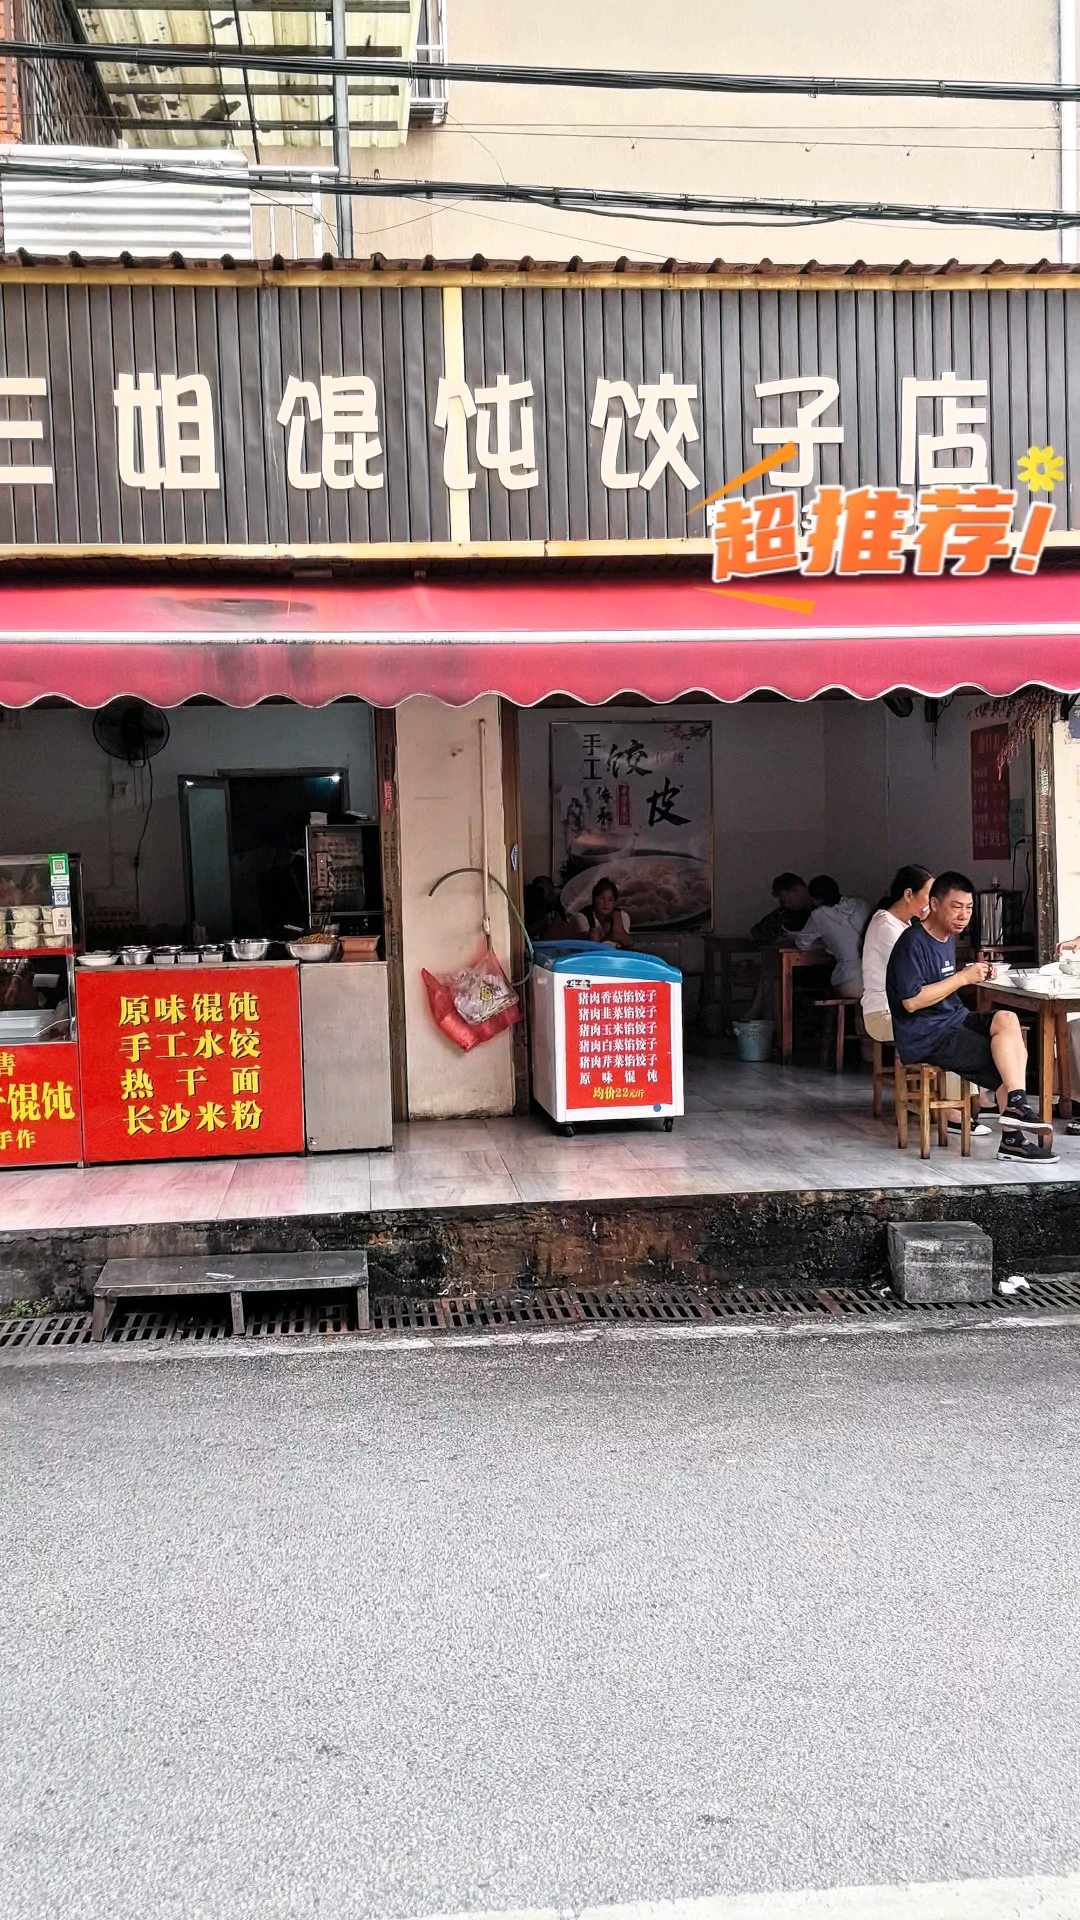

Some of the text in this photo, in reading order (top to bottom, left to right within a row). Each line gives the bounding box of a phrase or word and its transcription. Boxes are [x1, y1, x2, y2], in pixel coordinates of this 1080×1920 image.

[583, 734, 602, 779] 手工
[119, 991, 260, 1026] 原味馄饨
[578, 989, 657, 1005] 猪肉香菇馅饺子
[578, 1005, 657, 1021] 猪肉韭菜馅饺子
[579, 1021, 657, 1037] 猪肉玉米馅饺子
[119, 1028, 261, 1063] 手工水饺
[579, 1037, 657, 1053] 猪肉白菜馅饺子
[579, 1053, 658, 1069] 猪肉芹菜馅饺子
[120, 1064, 261, 1100] 热干面
[580, 1070, 658, 1085] 原味馄饨
[0, 1081, 76, 1122] 馄饨
[122, 1100, 262, 1136] 长沙米粉
